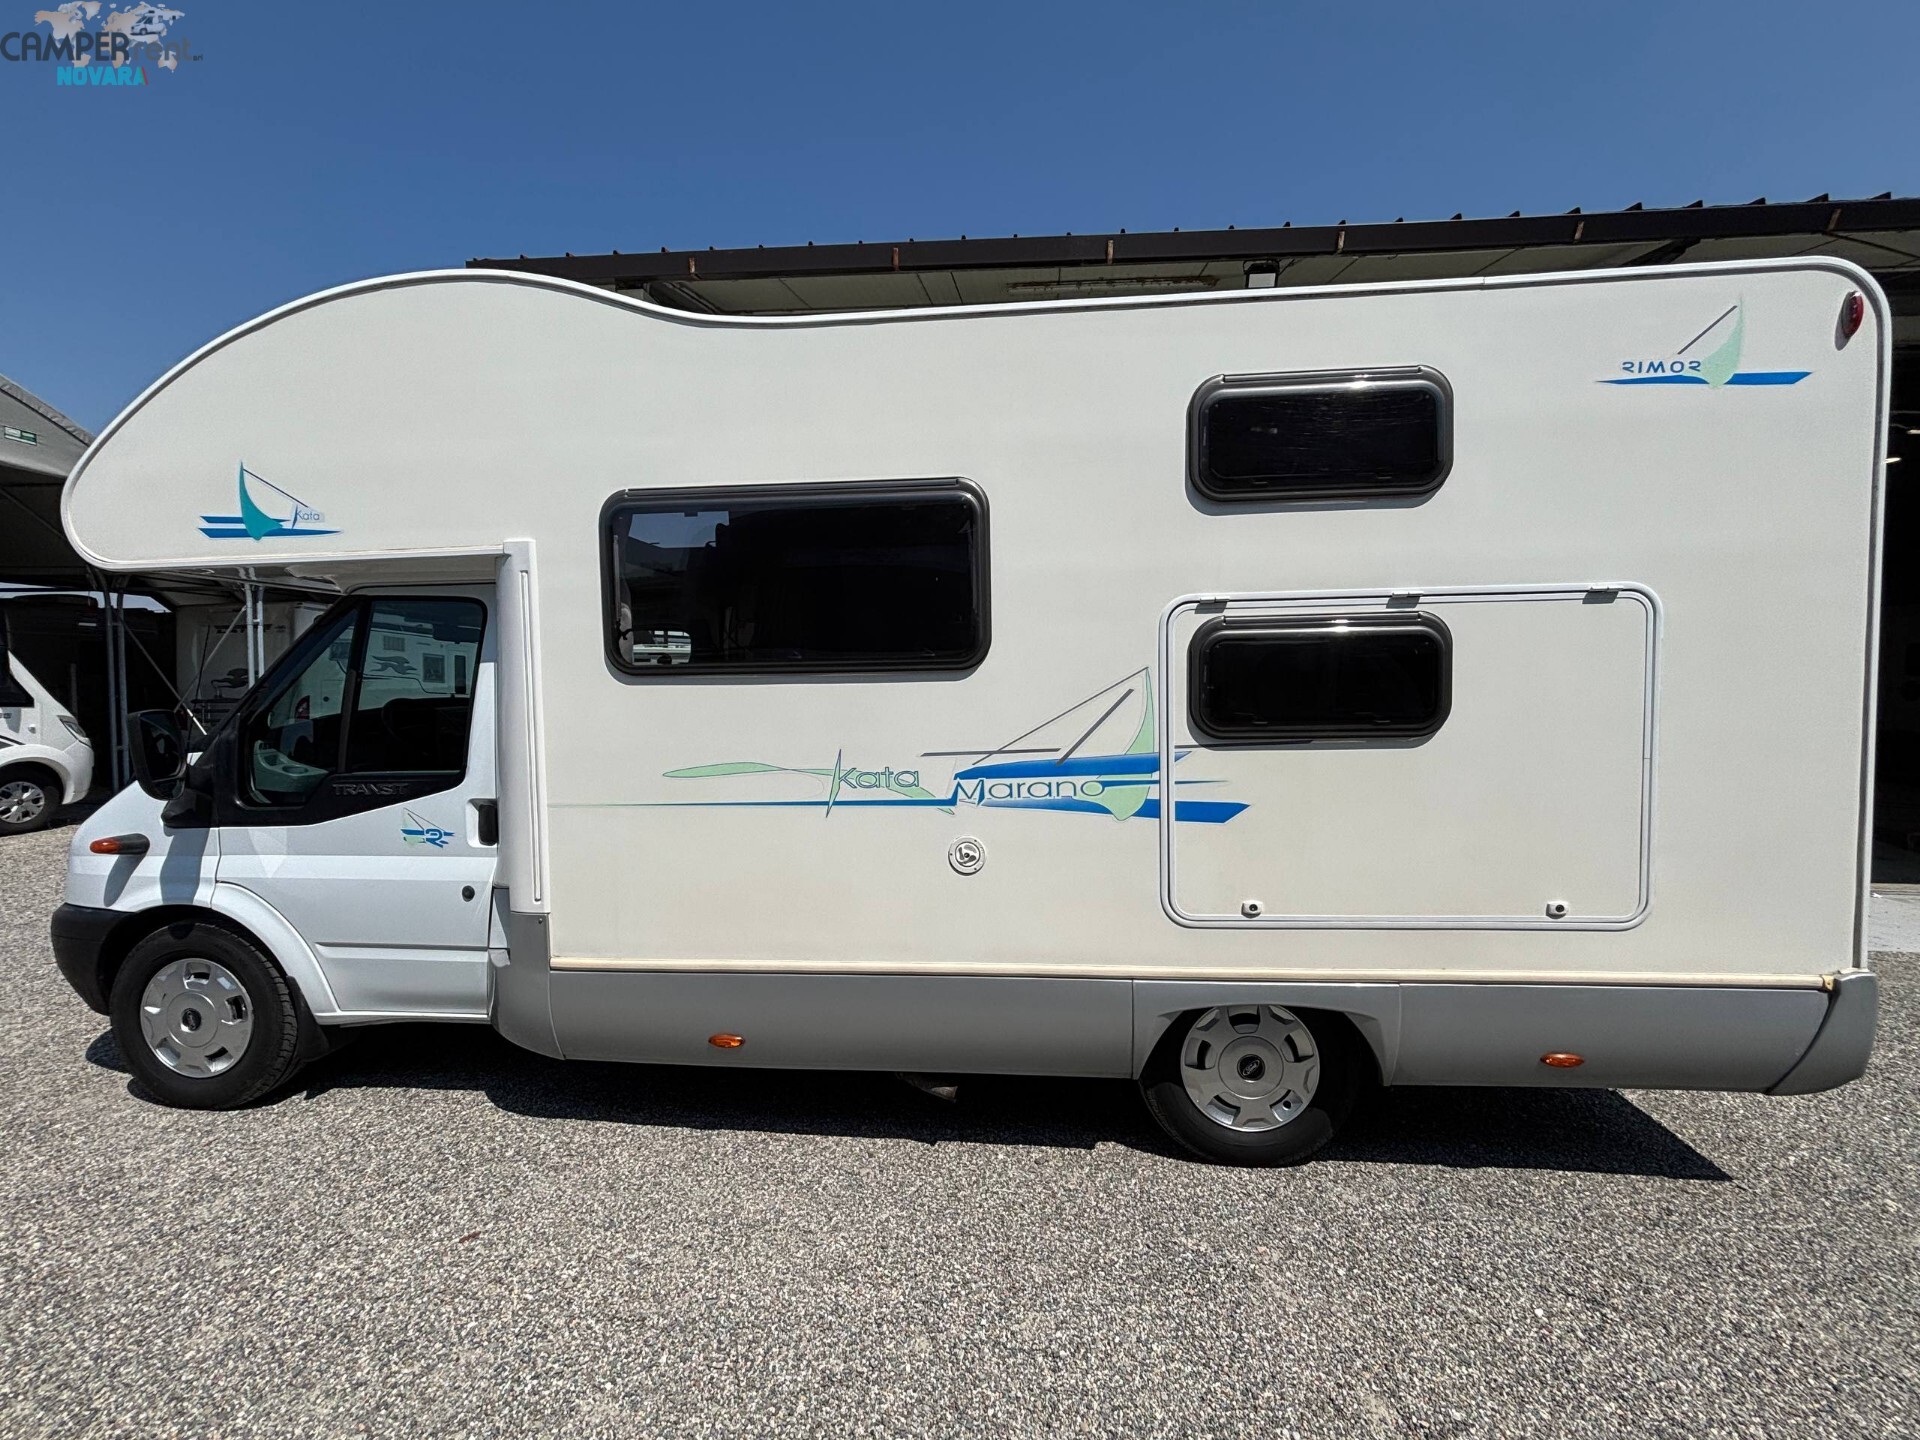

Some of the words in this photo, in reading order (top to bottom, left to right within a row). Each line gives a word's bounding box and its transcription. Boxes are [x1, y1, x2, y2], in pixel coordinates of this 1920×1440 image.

[1622, 360, 1702, 374] RIMOR
[332, 783, 409, 796] TRANSIT
[955, 777, 1106, 805] Marano
